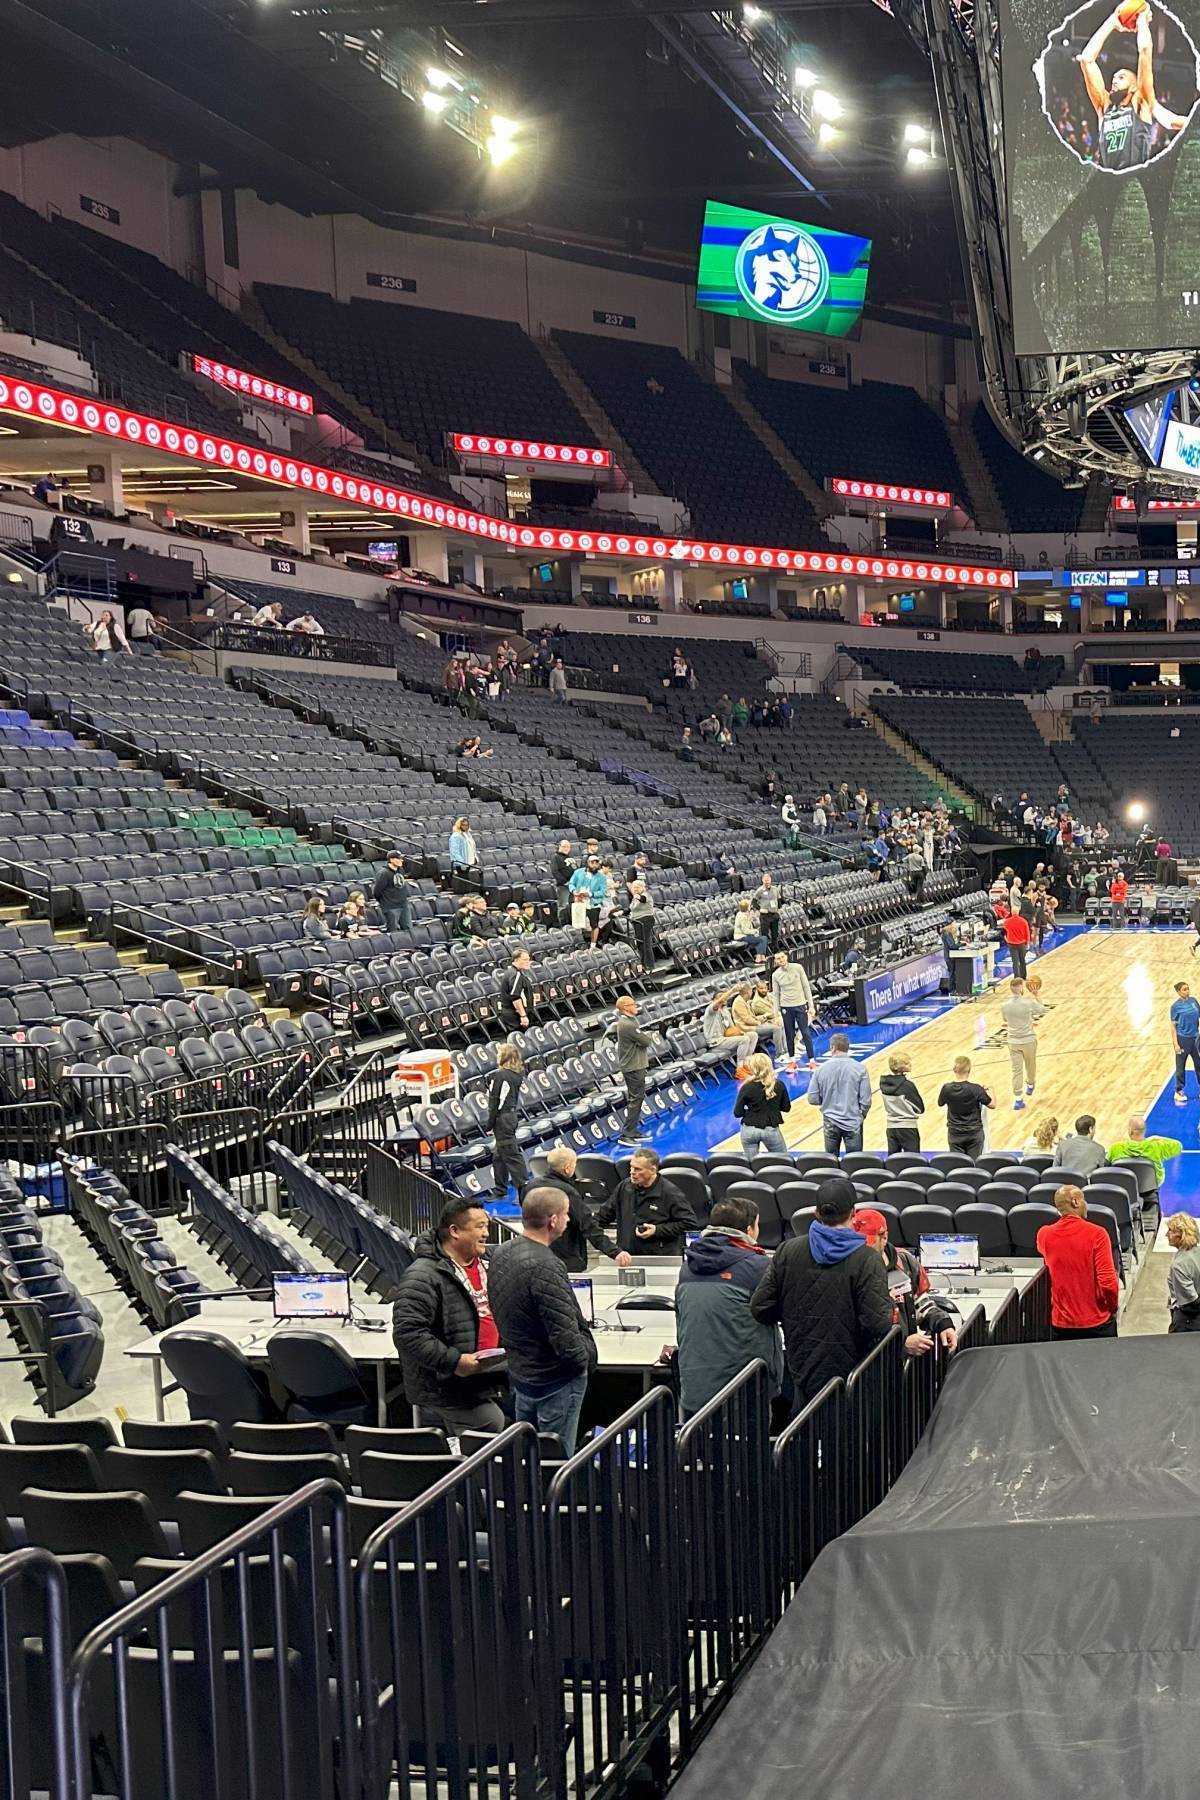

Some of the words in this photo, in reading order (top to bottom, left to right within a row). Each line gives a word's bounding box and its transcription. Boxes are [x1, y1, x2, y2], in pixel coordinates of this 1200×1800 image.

[1105, 127, 1128, 153] 27
[91, 203, 110, 219] 235
[381, 276, 403, 290] 236
[605, 314, 624, 325] 237
[62, 517, 81, 534] 132
[277, 561, 291, 573] 133
[1072, 572, 1107, 585] KFAN
[636, 615, 651, 624] 136
[870, 989, 892, 1010] There
[892, 981, 903, 998] for
[902, 974, 920, 994] what
[920, 965, 943, 986] matters
